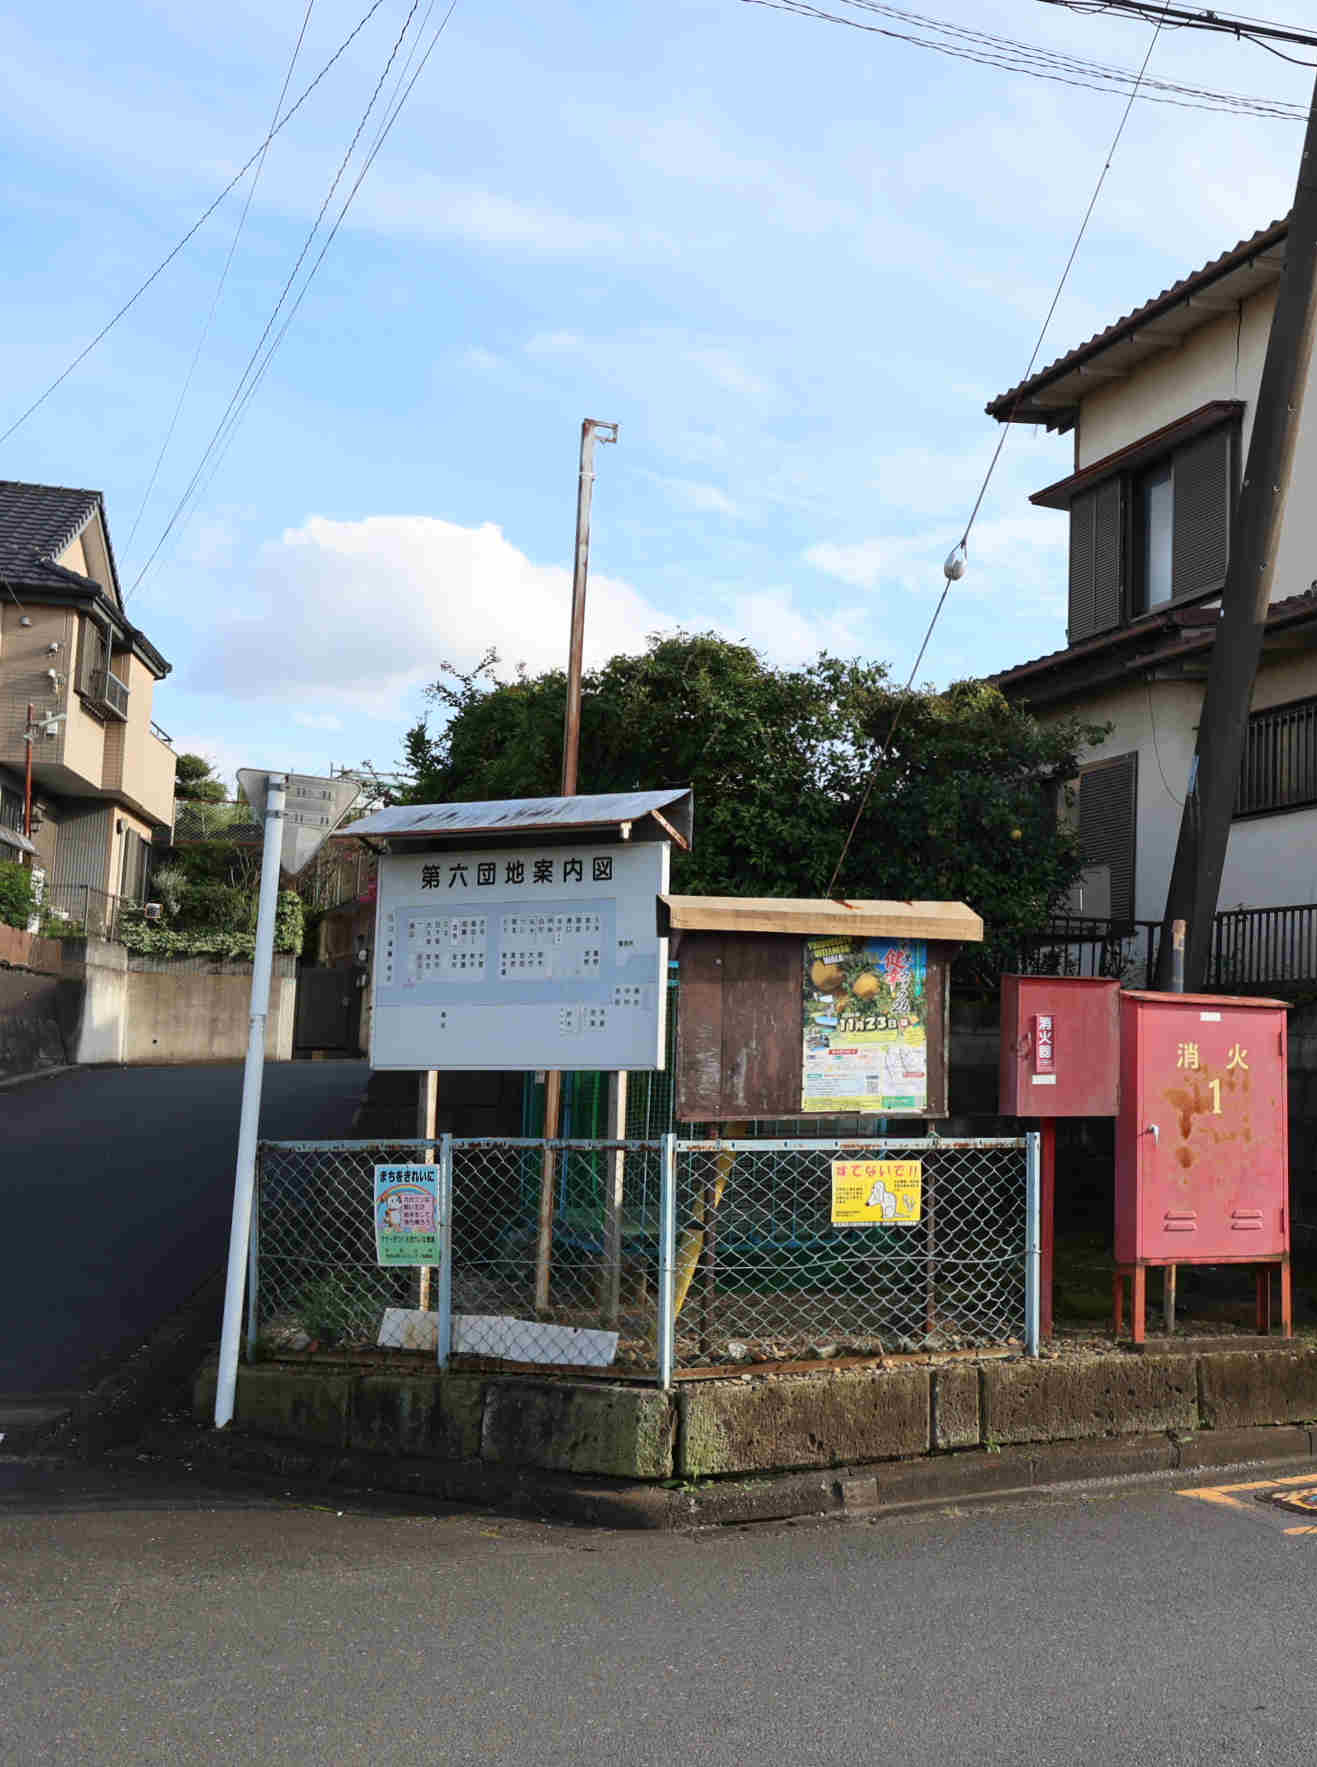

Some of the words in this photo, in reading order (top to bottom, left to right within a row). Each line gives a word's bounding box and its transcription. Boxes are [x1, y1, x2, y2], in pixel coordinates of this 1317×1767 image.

[421, 855, 613, 889] 第六団地案内図
[1039, 1015, 1052, 1058] 消火器
[1176, 1042, 1249, 1070] 消火
[1208, 1078, 1223, 1114] 1
[379, 1170, 435, 1183] まちをきれいに
